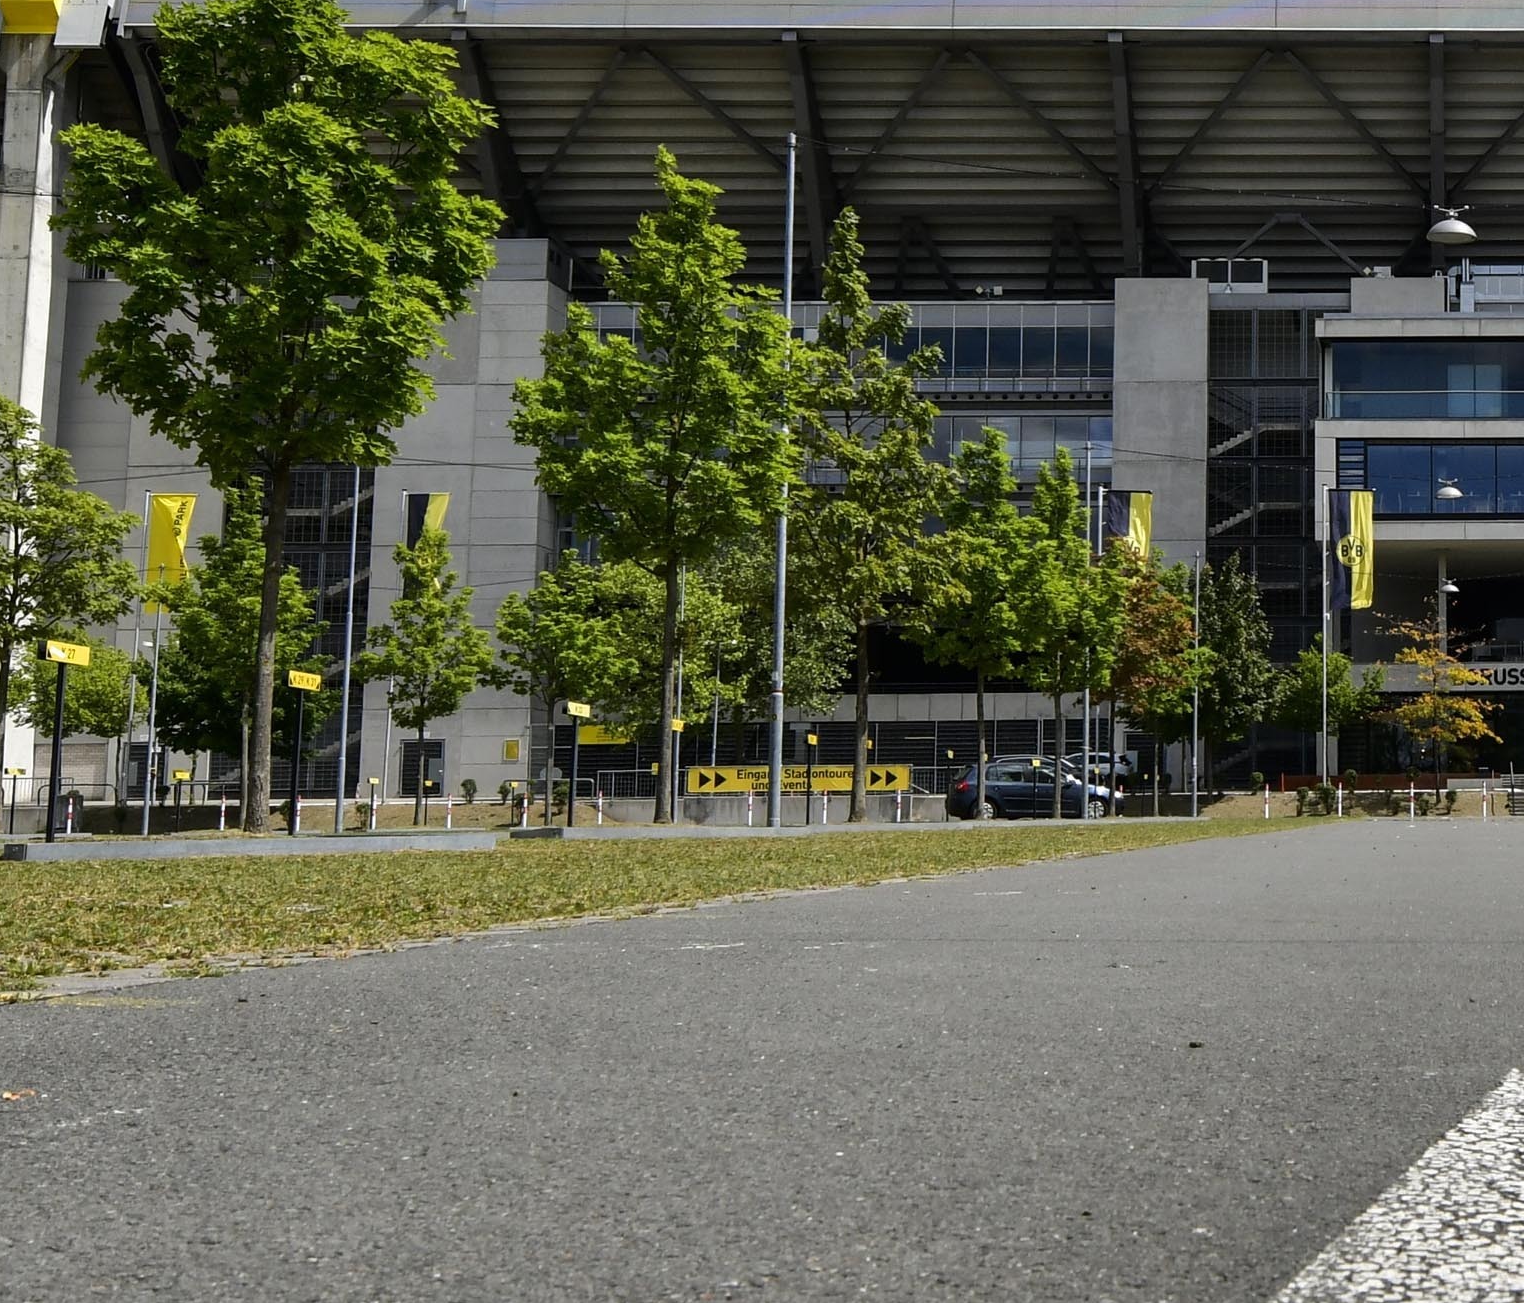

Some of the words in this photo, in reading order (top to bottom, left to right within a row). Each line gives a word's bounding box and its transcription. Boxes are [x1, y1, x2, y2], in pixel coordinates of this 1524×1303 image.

[173, 500, 189, 526] PARK
[1341, 538, 1363, 557] BVB
[67, 648, 76, 660] 27
[736, 769, 769, 781] Einga
[784, 768, 853, 779] Stadontoure
[781, 780, 812, 790] vents
